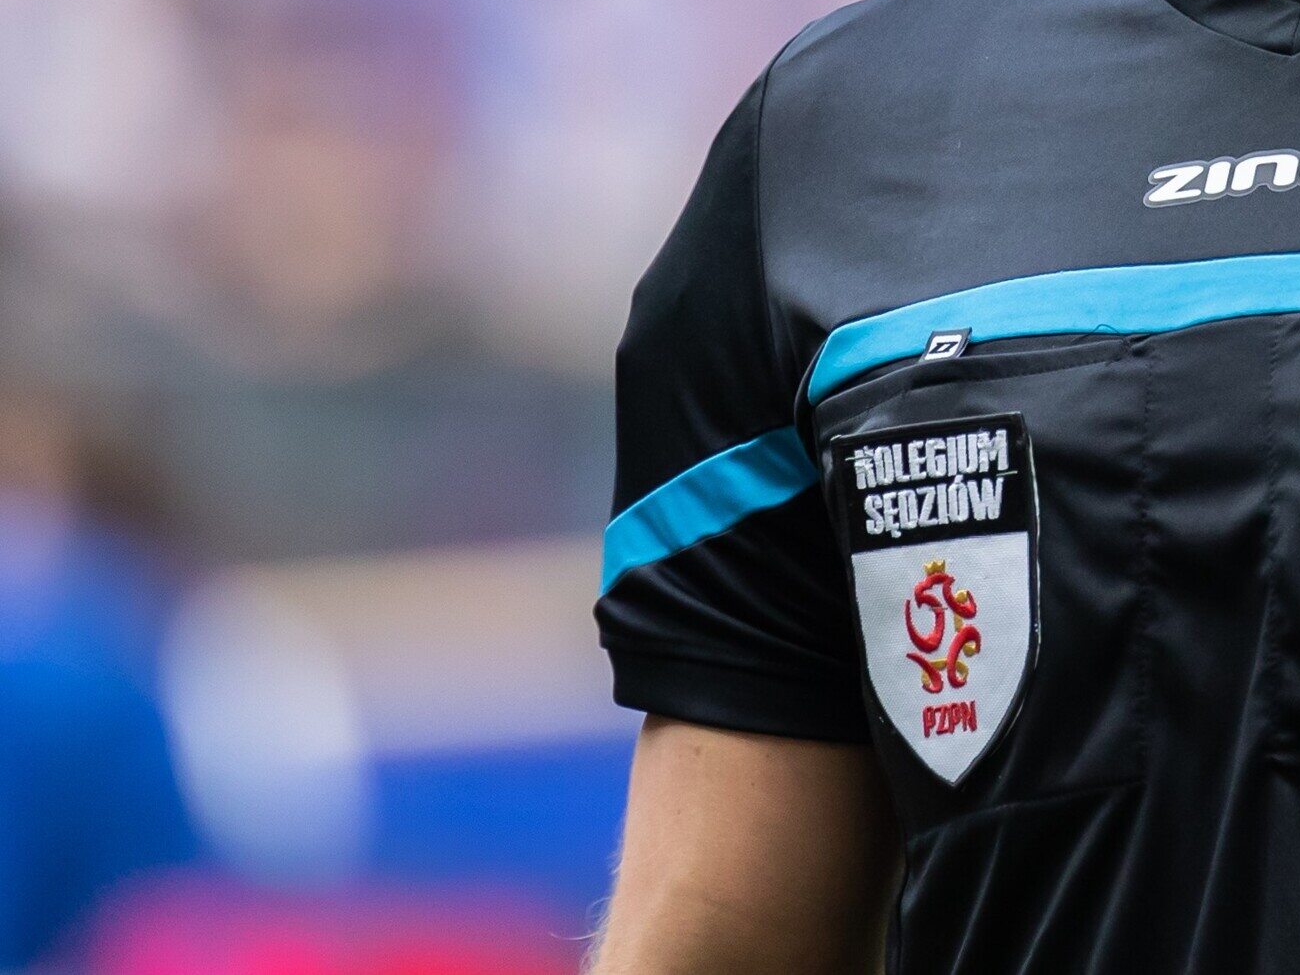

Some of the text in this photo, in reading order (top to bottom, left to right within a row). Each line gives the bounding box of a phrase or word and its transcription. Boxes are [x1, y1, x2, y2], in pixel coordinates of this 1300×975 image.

[854, 429, 1010, 490] KOLEGIUM
[863, 475, 1005, 539] SĘDZIÓW
[921, 699, 978, 739] PZPN
